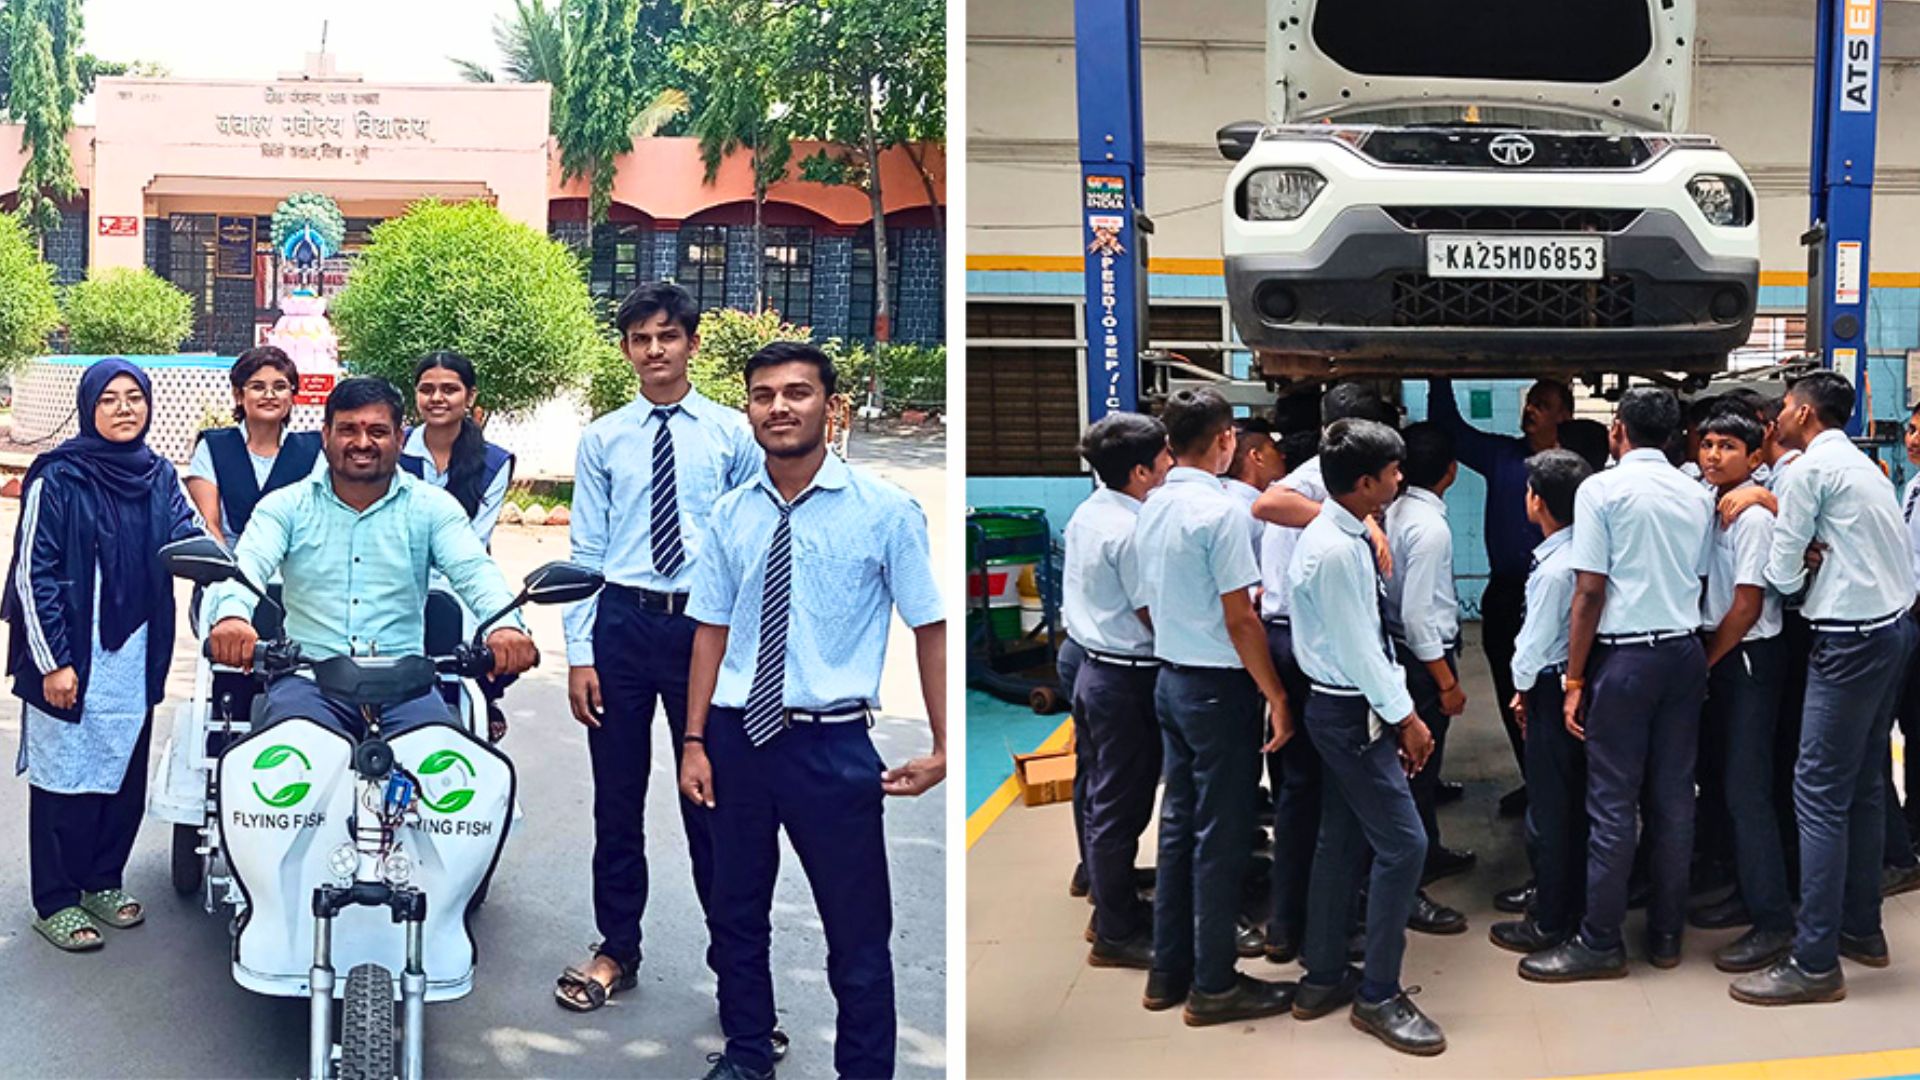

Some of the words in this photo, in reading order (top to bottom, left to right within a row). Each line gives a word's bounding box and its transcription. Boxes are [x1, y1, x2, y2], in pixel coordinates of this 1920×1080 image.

[1849, 0, 1872, 29] E
[1846, 40, 1869, 105] ATS
[1087, 199, 1124, 209] INDIA
[1447, 244, 1598, 271] KA25MD6853
[233, 811, 289, 829] FLYING
[294, 812, 326, 828] FISH
[456, 820, 492, 837] FISH
